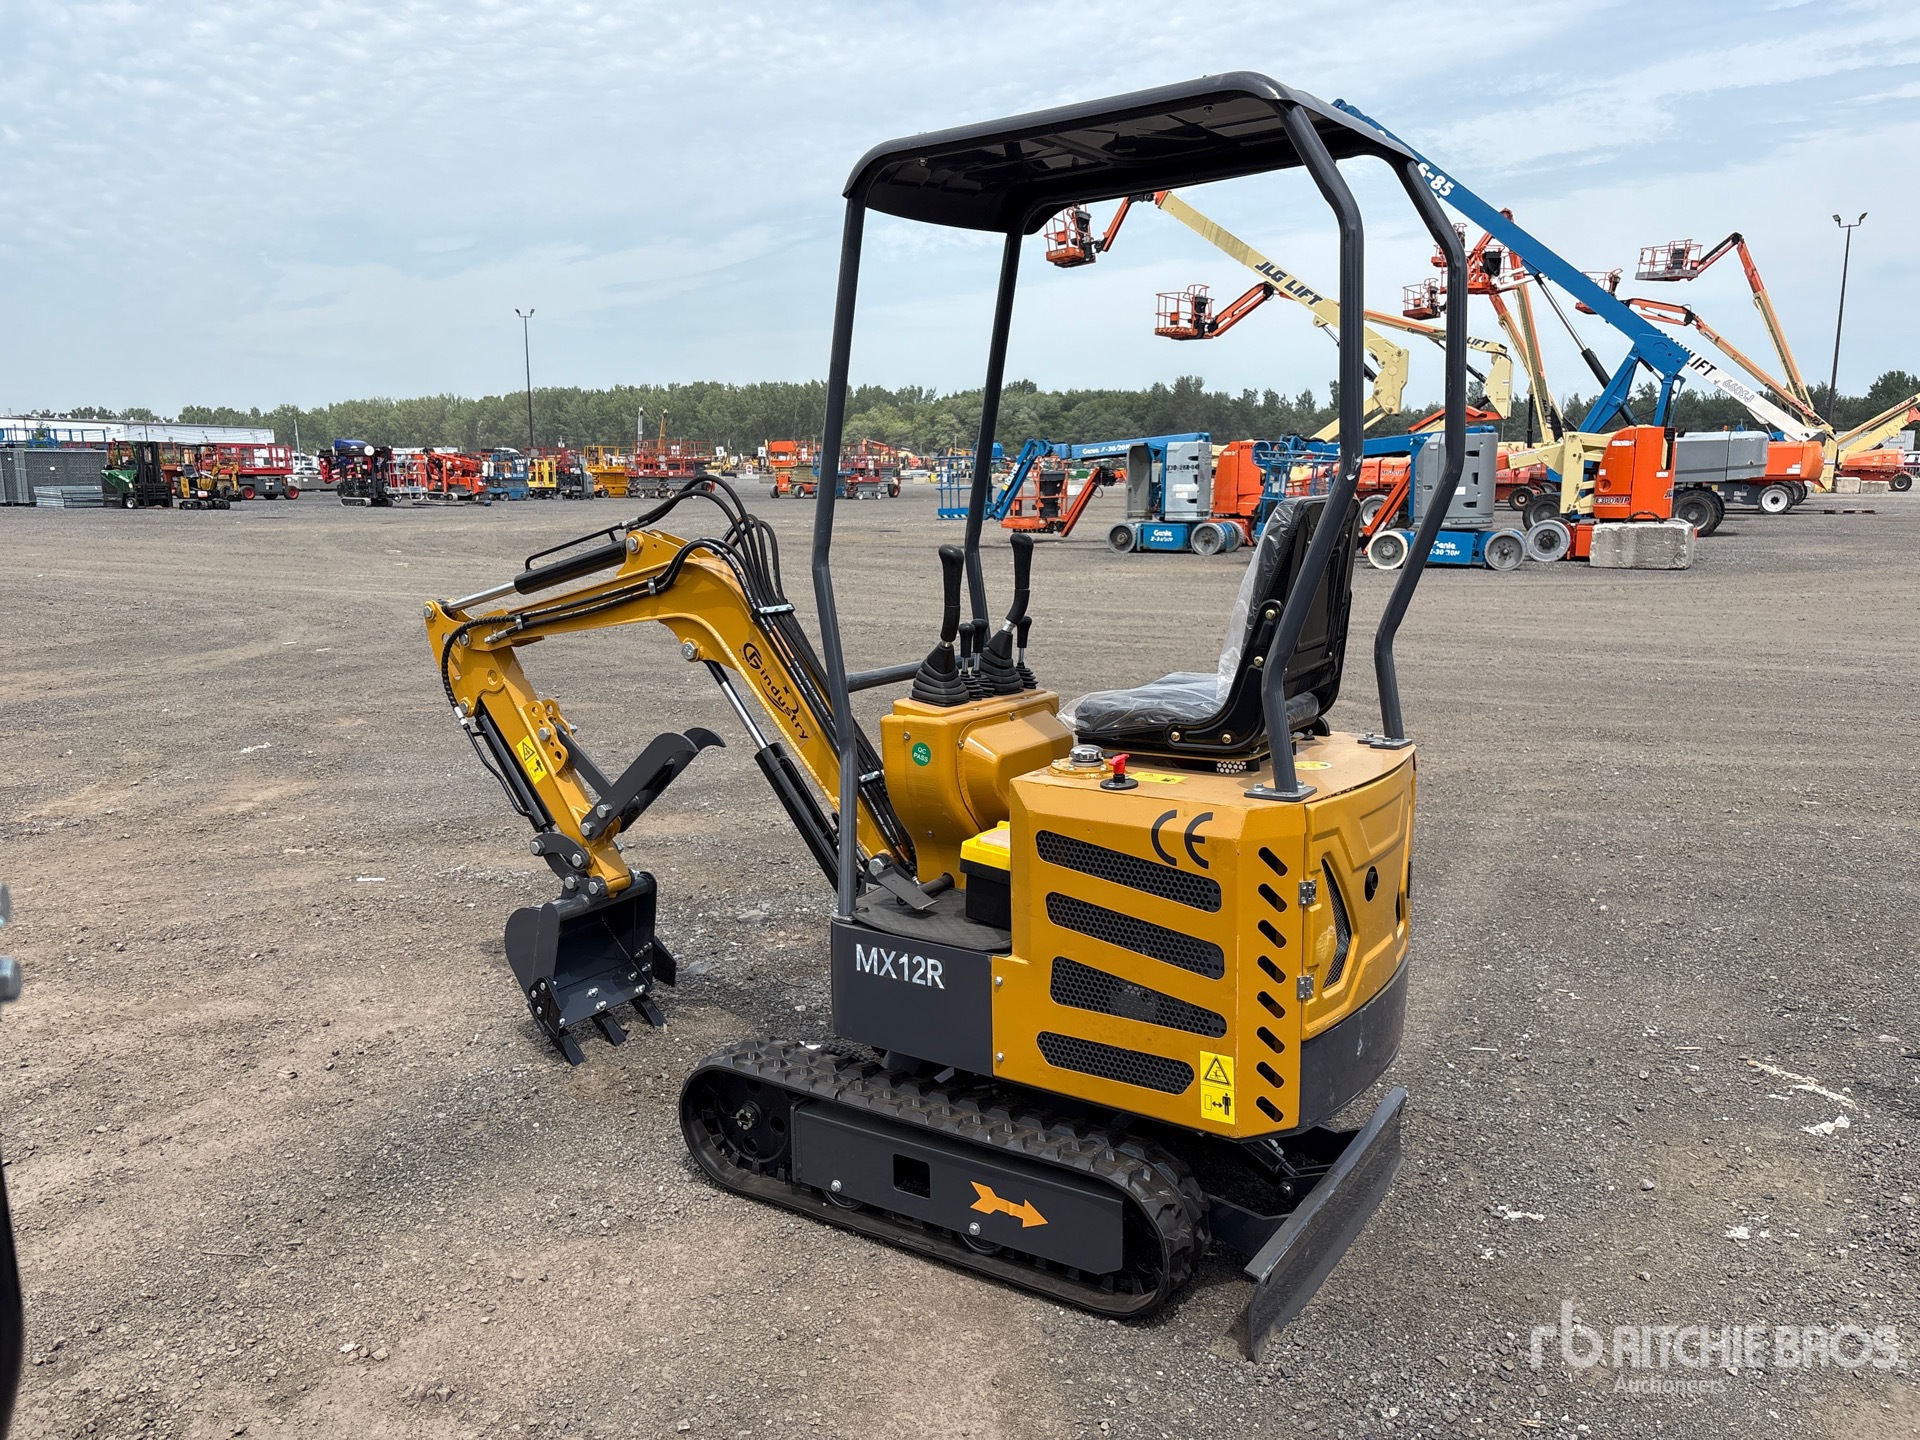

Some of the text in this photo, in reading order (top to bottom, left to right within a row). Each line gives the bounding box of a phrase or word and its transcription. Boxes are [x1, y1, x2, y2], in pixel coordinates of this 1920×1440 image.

[1417, 162, 1455, 197] S-85
[1254, 261, 1323, 306] JLG LIFT
[1686, 357, 1717, 376] IFT
[1722, 379, 1755, 403] 660SJ
[913, 752, 929, 763] PASS
[1151, 809, 1213, 869] CE
[855, 943, 945, 990] MX12R
